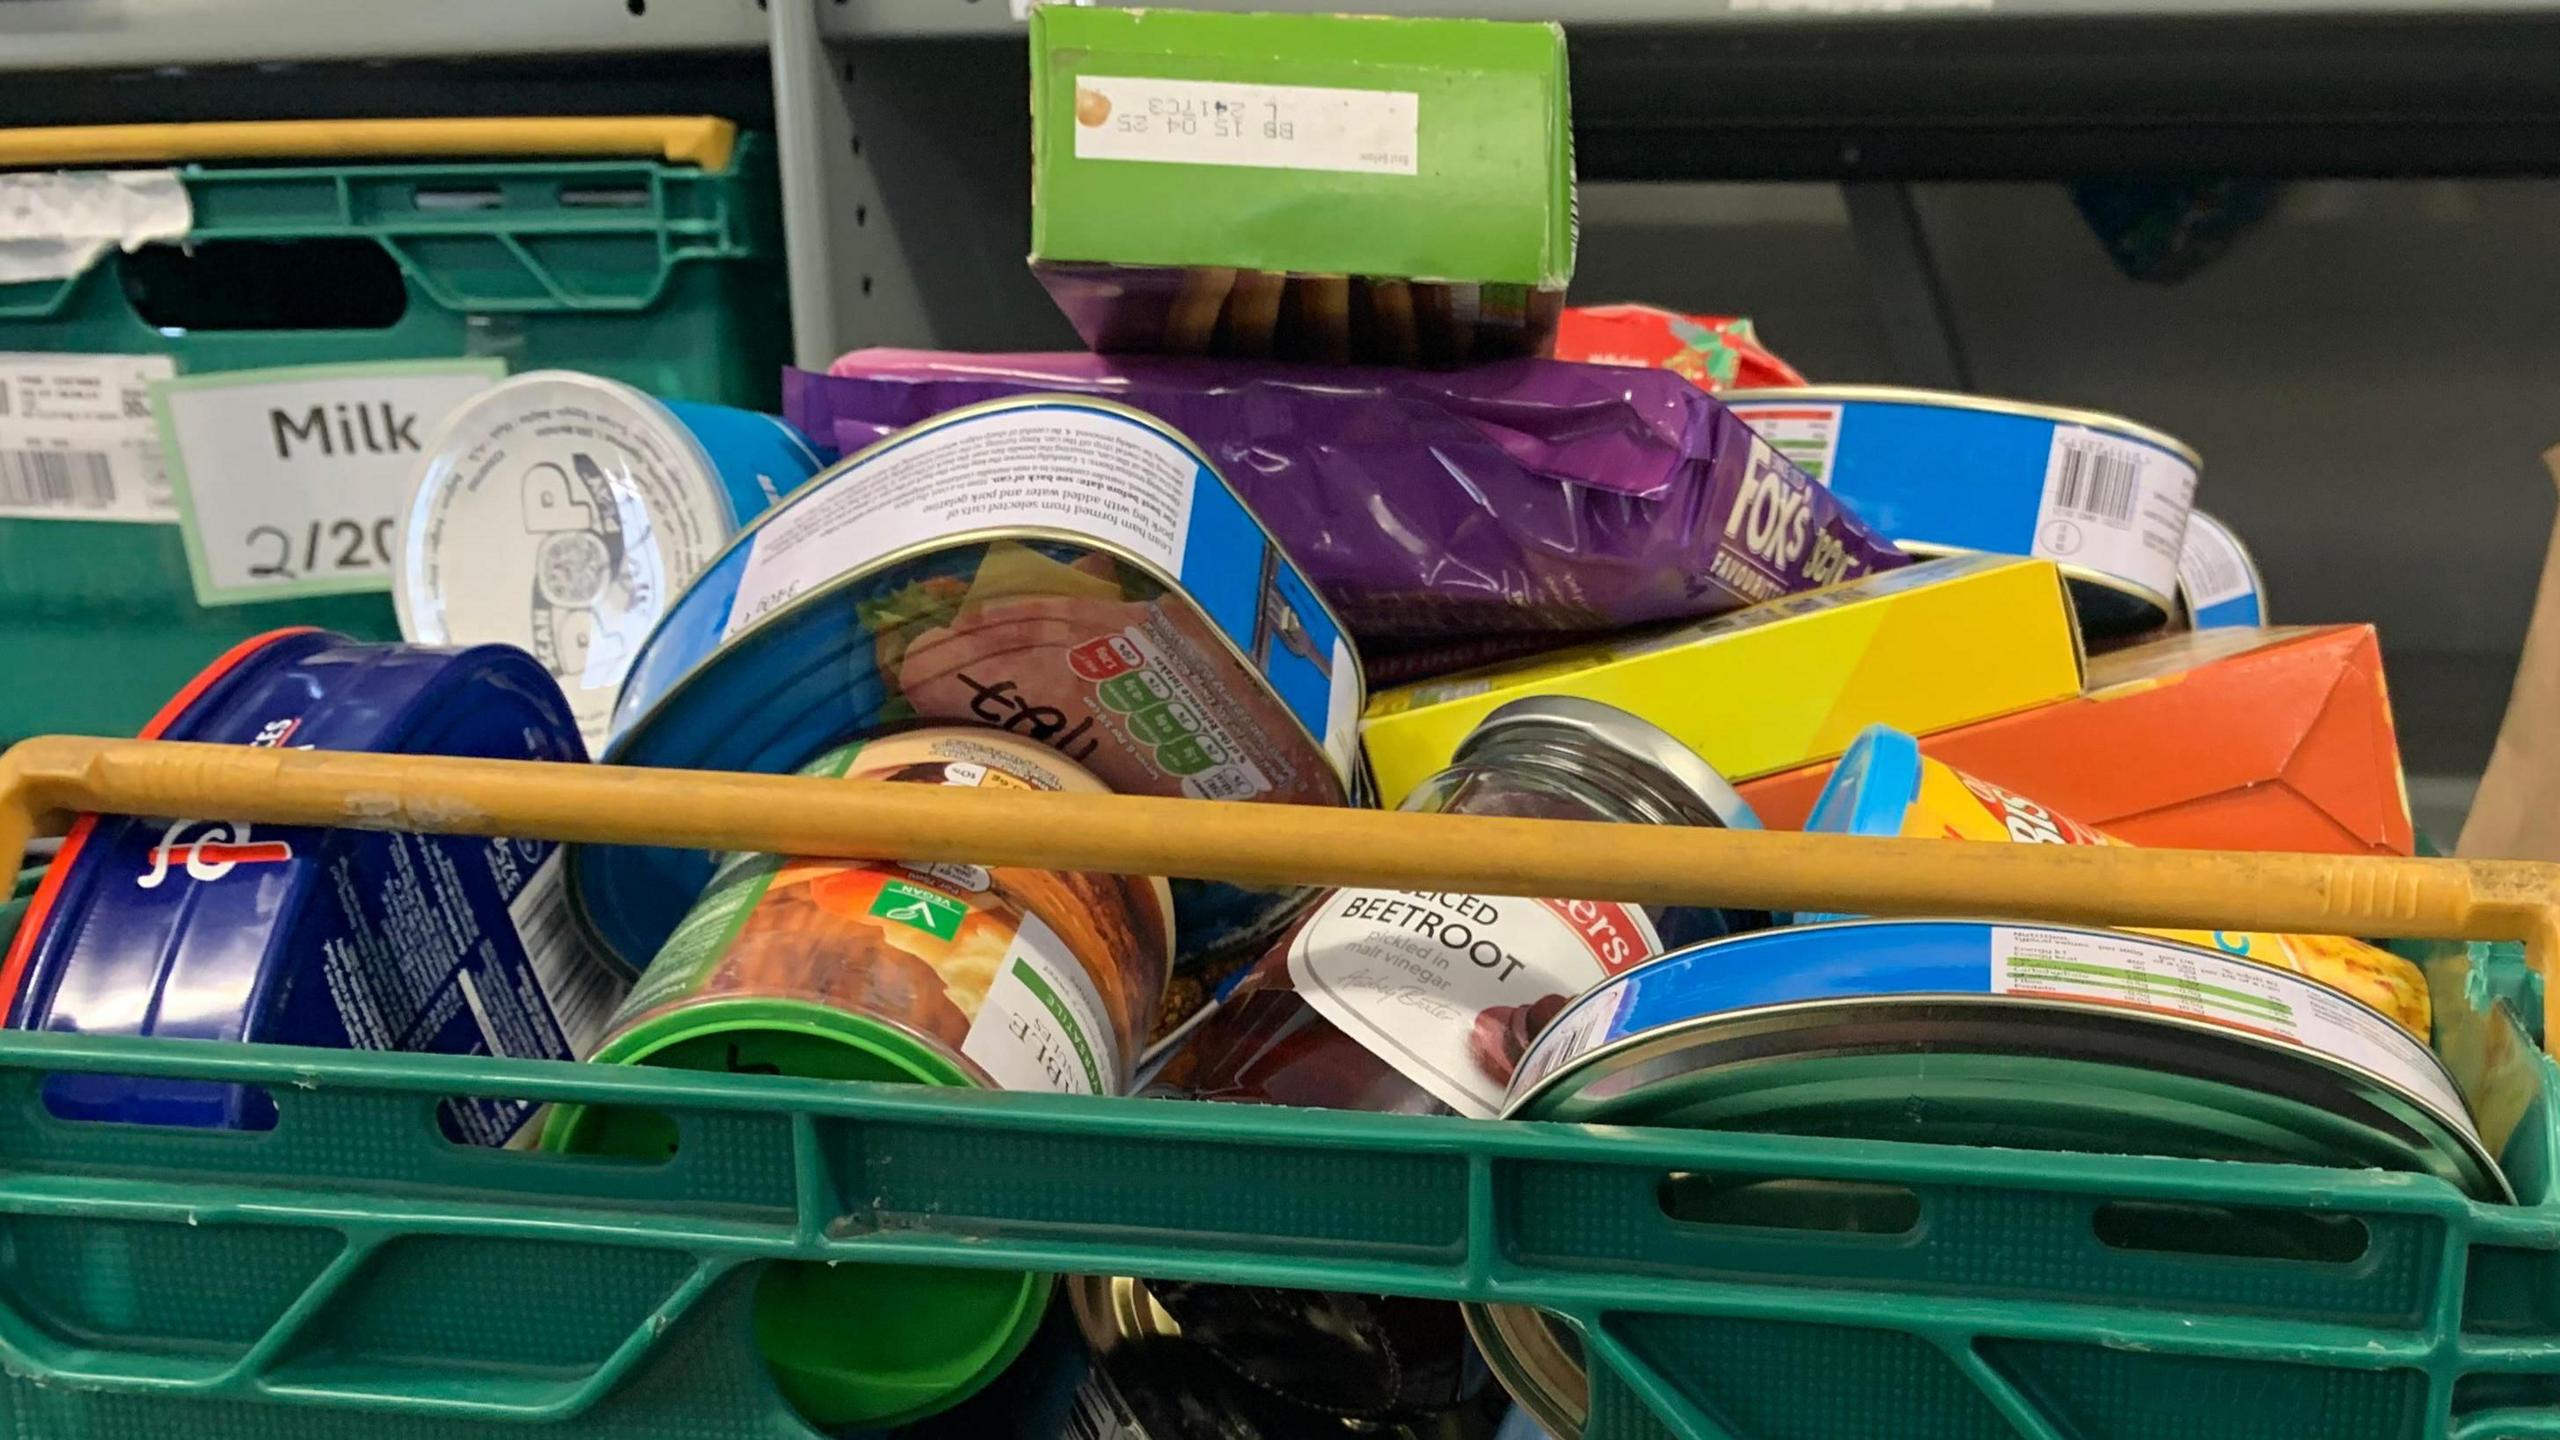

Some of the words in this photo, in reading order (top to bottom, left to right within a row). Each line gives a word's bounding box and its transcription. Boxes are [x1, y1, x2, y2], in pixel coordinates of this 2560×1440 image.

[1116, 114, 1149, 132] 25
[1168, 116, 1197, 136] 04
[1214, 118, 1241, 138] 15
[1263, 120, 1294, 140] BB
[272, 402, 420, 459] Milk
[990, 475, 1012, 483] can.
[1014, 475, 1025, 483] of
[1027, 474, 1053, 483] back
[1055, 475, 1073, 483] see
[1076, 479, 1104, 490] date:
[971, 489, 997, 502] pork
[999, 489, 1022, 499] and
[1026, 488, 1059, 498] water
[1062, 490, 1100, 503] added
[1106, 485, 1139, 504] before
[960, 505, 985, 516] cuts
[987, 501, 1038, 514] selected
[1041, 502, 1070, 513] from
[1074, 505, 1118, 526] formed
[1103, 499, 1129, 514] with
[1142, 499, 1160, 516] best
[1132, 508, 1149, 526] leg
[1120, 519, 1146, 539] ham
[1151, 520, 1174, 541] pork
[1148, 533, 1172, 554] Lean
[1153, 656, 1182, 689] Intakes
[1181, 686, 1219, 732] Reference
[1216, 727, 1232, 744] the
[901, 885, 951, 908] VEGAN
[1398, 889, 1499, 926] LICED
[1341, 897, 1525, 983] BEETROOT
[1363, 930, 1432, 958] pickled
[1432, 950, 1451, 971] in
[1345, 942, 1383, 962] malt
[1382, 952, 1452, 991] vinegar
